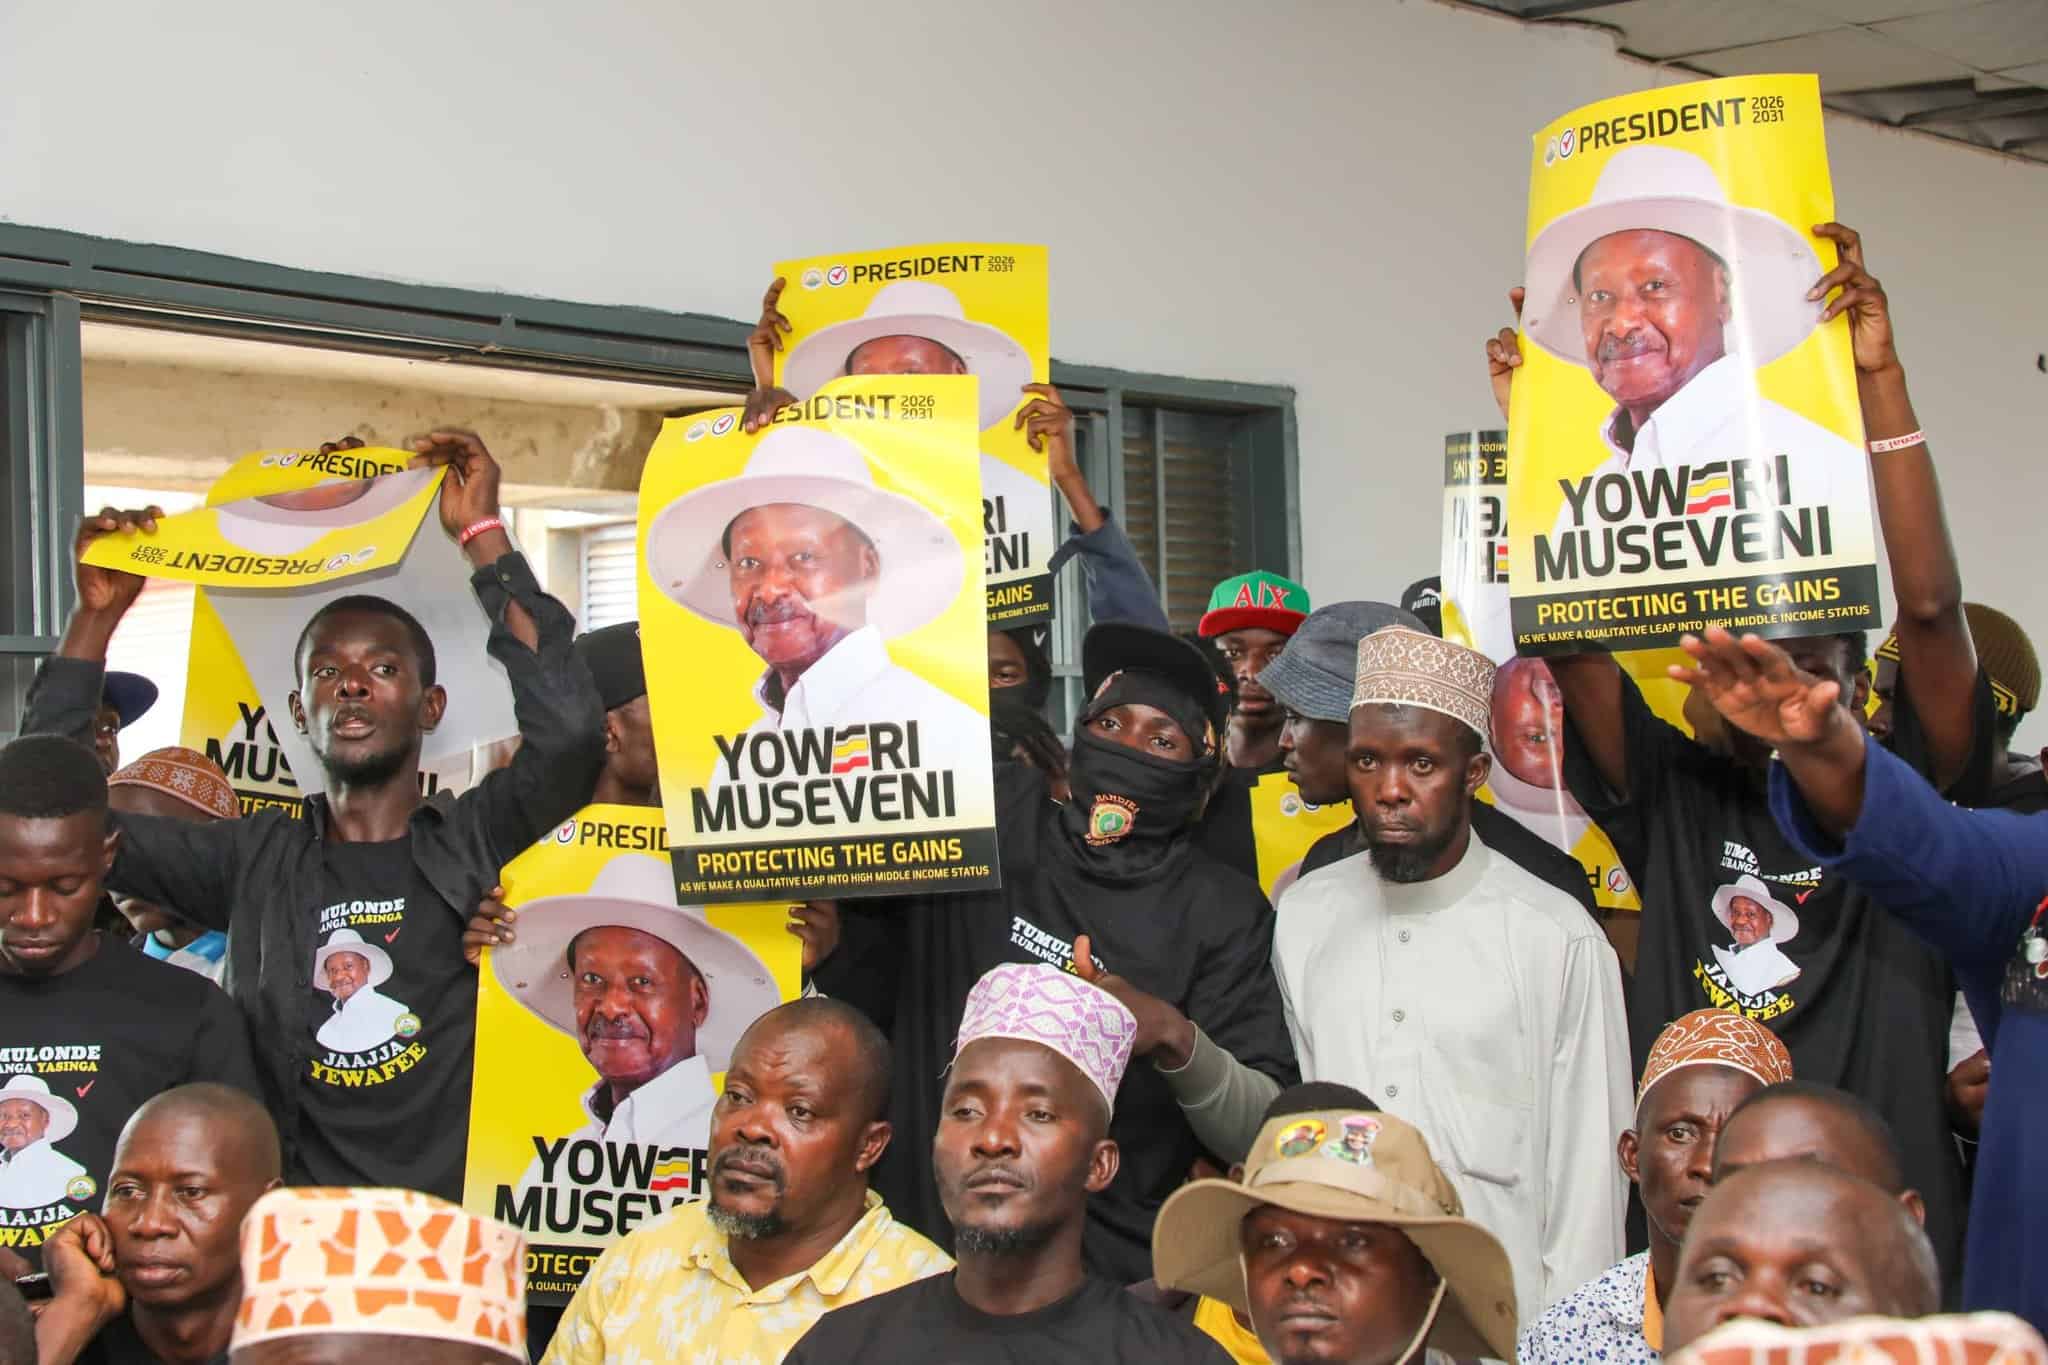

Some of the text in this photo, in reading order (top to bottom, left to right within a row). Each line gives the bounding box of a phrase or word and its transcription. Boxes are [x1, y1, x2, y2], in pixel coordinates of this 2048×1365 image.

[1579, 96, 1784, 153] PRESIDENT 2026
[1752, 110, 1784, 123] 2031
[853, 255, 1015, 284] PRESIDENT 2026
[988, 264, 1014, 272] 2031
[901, 395, 935, 407] 2026
[901, 407, 933, 420] 2031
[1558, 454, 1792, 526] YOWERI
[136, 545, 168, 557] 2031
[1533, 505, 1832, 583] MUSEVENI
[130, 551, 324, 575] PRESIDENT 2026
[1536, 577, 1841, 625] PROTECTING THE GAINS
[1519, 633, 1531, 645] AS
[1531, 632, 1547, 643] WE
[1549, 630, 1574, 642] MAKE
[1576, 629, 1583, 640] A
[1585, 624, 1648, 640] QUALITATIVE
[1650, 622, 1675, 634] LEAP
[1678, 619, 1703, 632] INTO
[1735, 614, 1777, 627] MIDDLE
[1781, 609, 1825, 623] INCOME
[1827, 604, 1871, 619] STATUS
[714, 720, 920, 781] YOWERI
[690, 769, 956, 833] MUSEVENI
[697, 838, 963, 876] PROTECTING THE GAINS
[680, 865, 989, 892] AS WE MAKE A QUALITATIVE LEAP INTO HIGH MIDDLE INCOME STATUS
[349, 911, 403, 925] YASINGA
[1010, 932, 1063, 967] KUBANGA
[36, 1061, 98, 1073] YASINGA
[311, 1042, 427, 1087] YEWAFEE
[323, 1041, 406, 1068] JAAJJA
